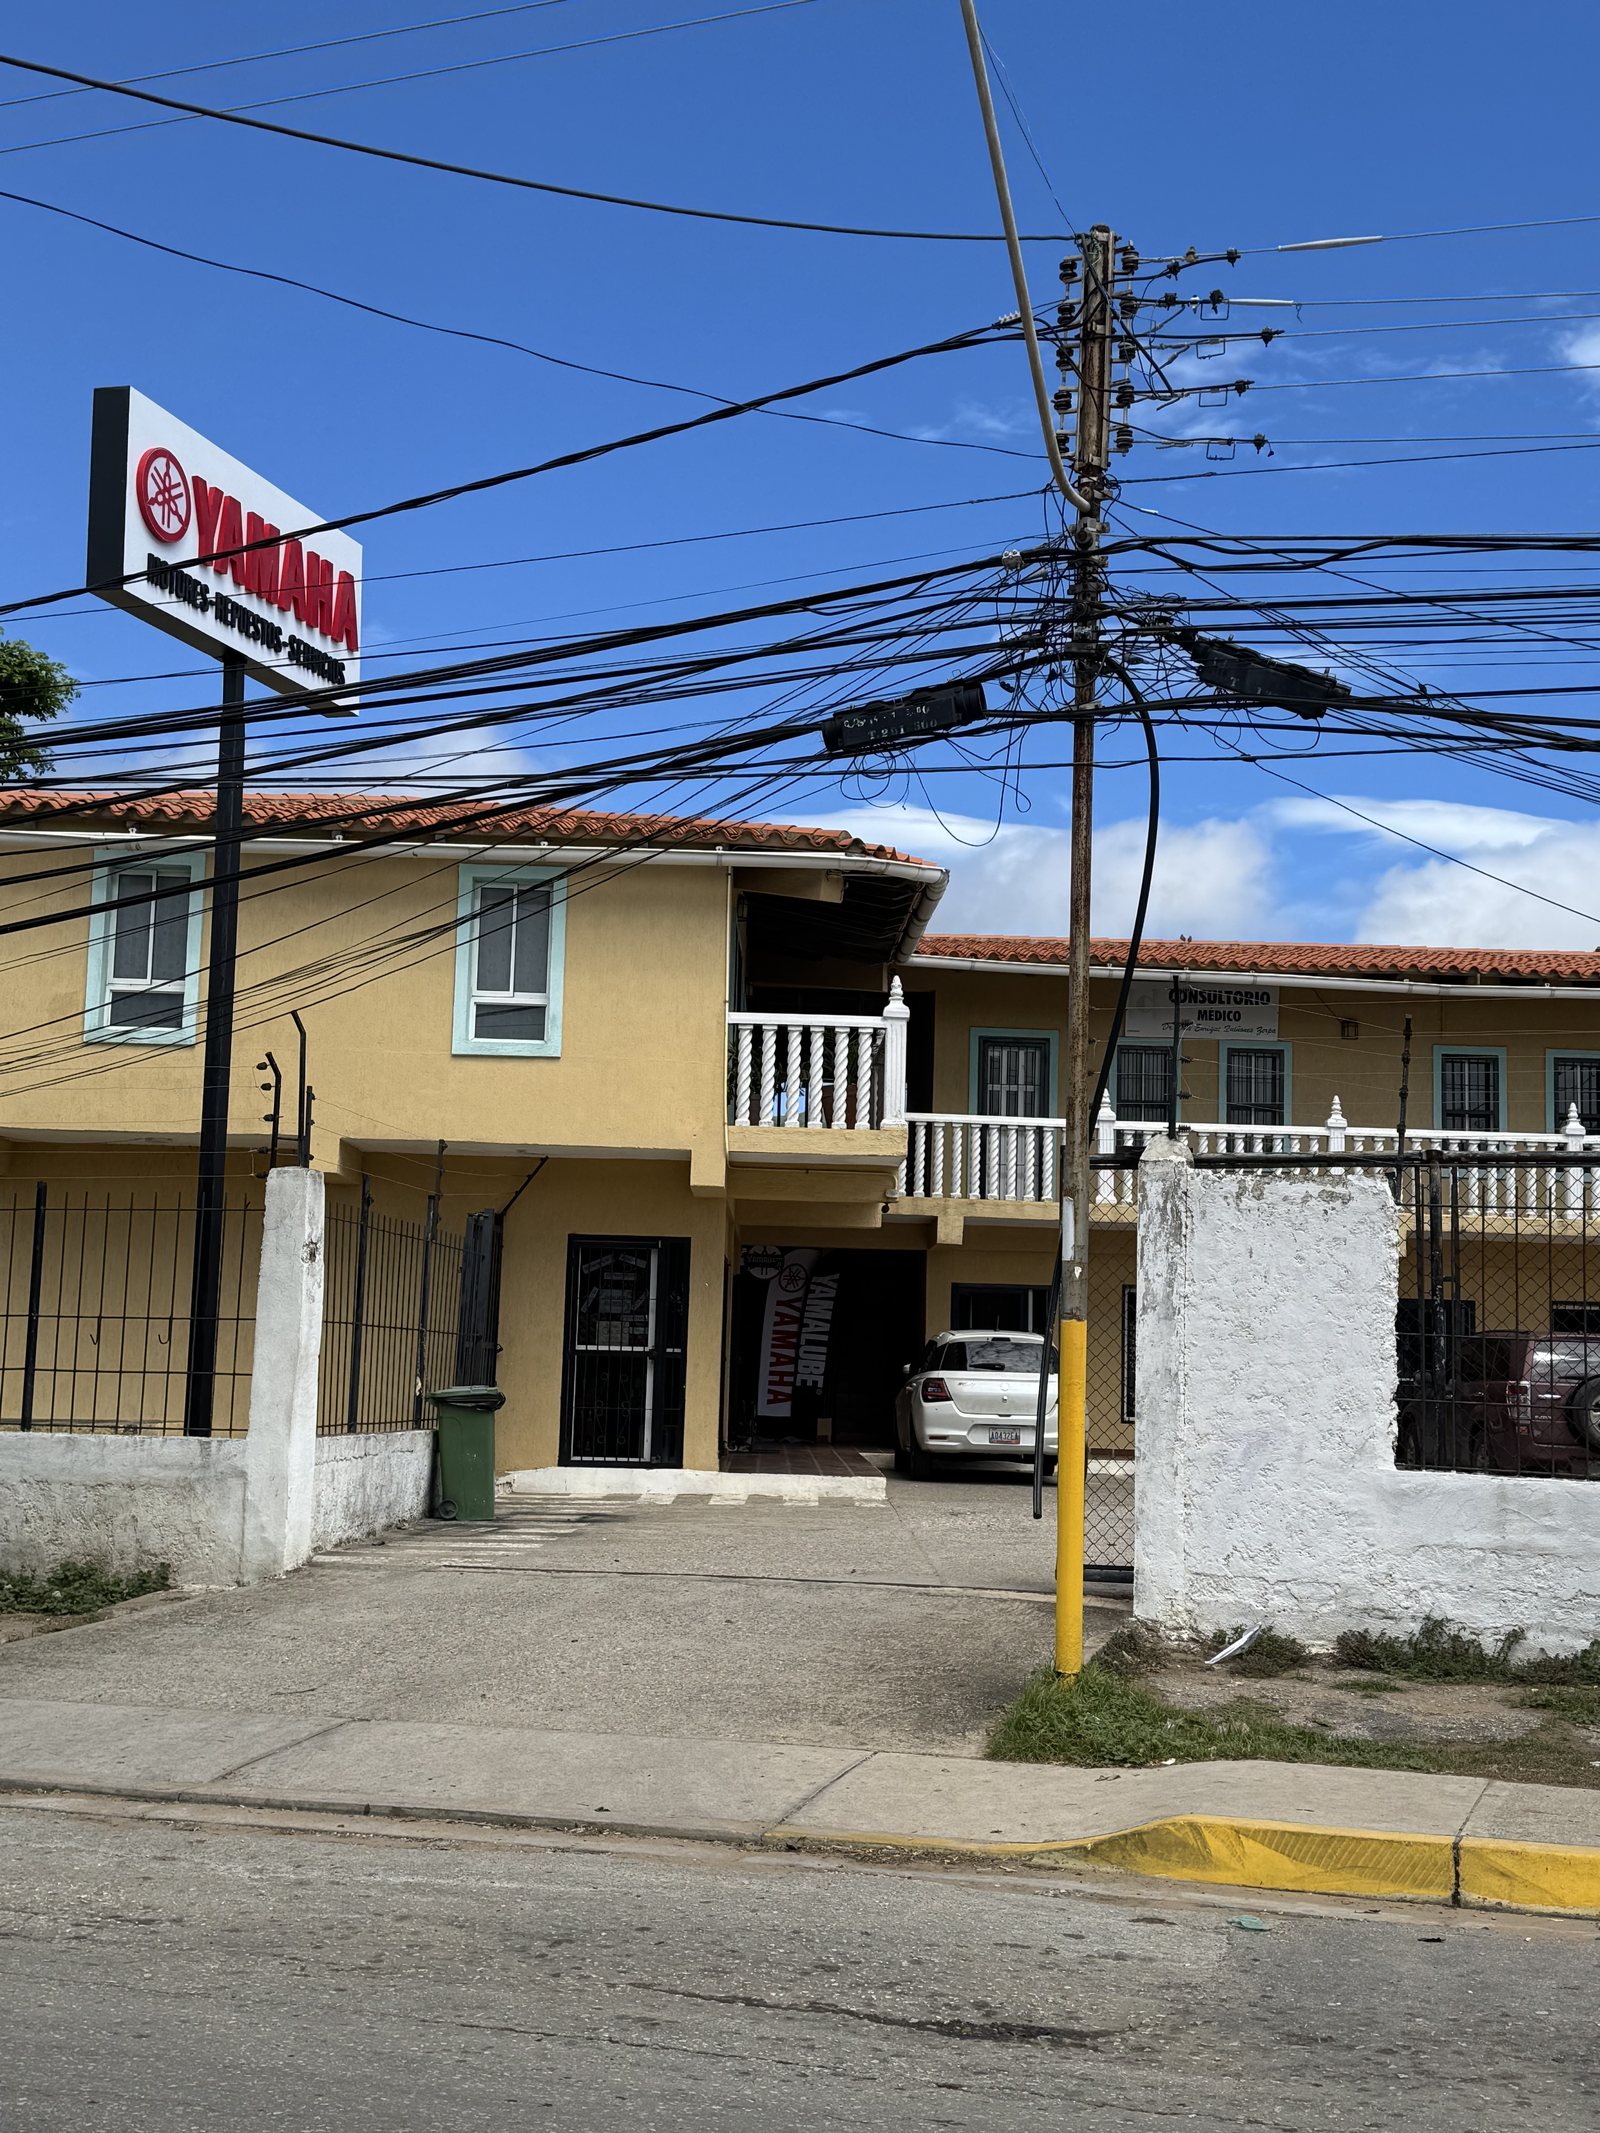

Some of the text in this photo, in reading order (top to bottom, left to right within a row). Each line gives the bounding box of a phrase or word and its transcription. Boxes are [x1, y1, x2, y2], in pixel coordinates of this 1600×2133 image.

[191, 475, 359, 652] YAMAHA
[1168, 988, 1271, 1006] CONSULTORIO
[1197, 1007, 1242, 1022] MÉDICO
[767, 1297, 803, 1406] YAMAHA
